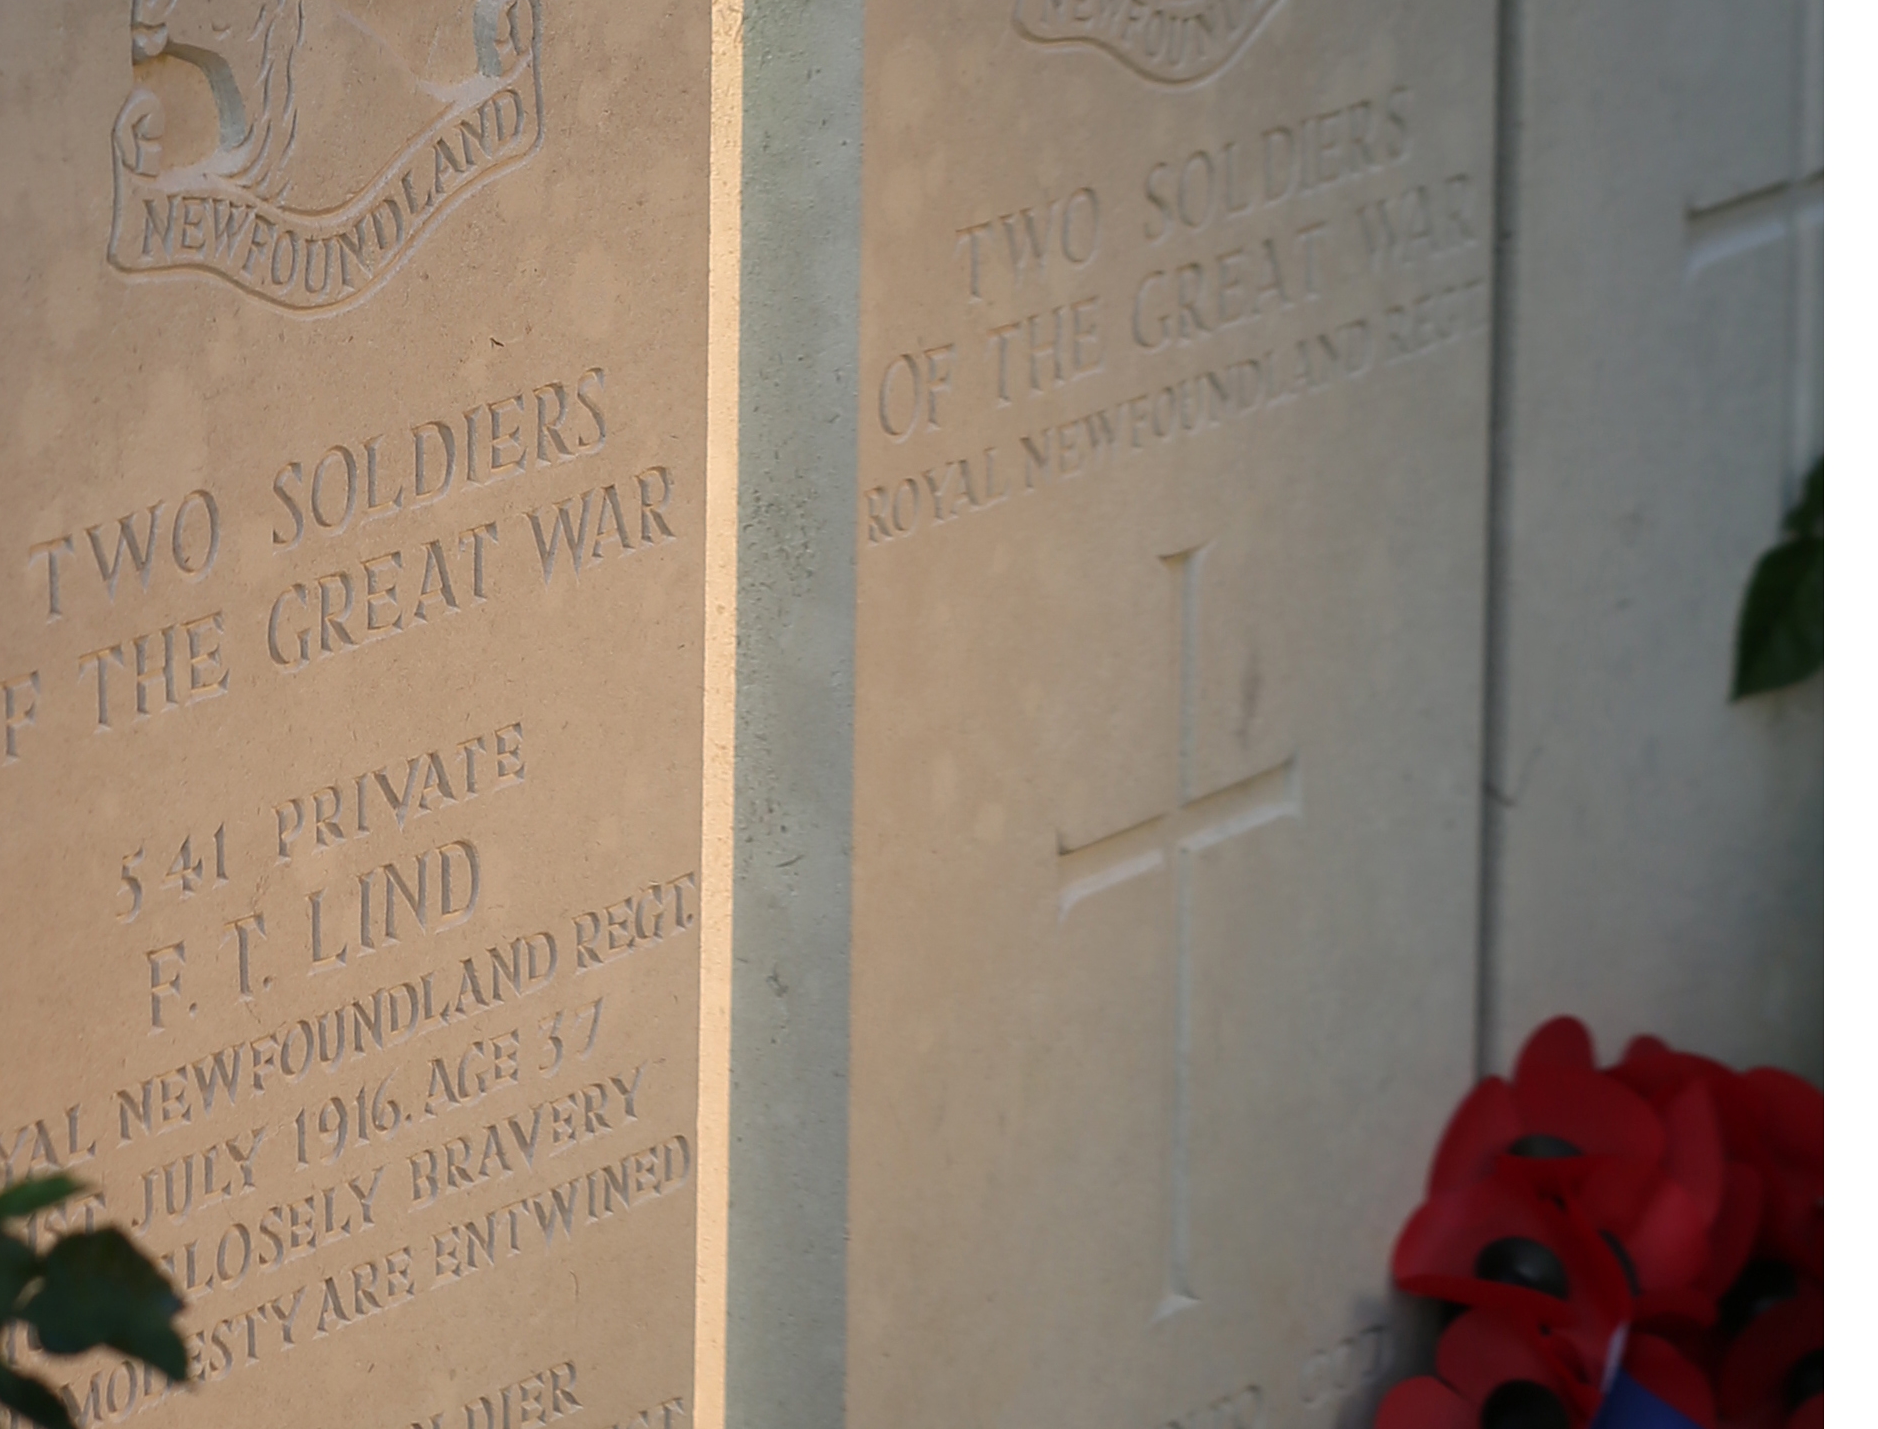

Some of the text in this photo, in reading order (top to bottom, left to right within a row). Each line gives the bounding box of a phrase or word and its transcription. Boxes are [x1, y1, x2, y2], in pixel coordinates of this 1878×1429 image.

[141, 87, 525, 297] NEWFOUNDLAND
[955, 86, 1414, 304] TWO SOLDIERS
[877, 173, 1479, 444] OF THE GREAT WAR
[28, 366, 610, 623] TWO SOLDIERS
[864, 447, 1012, 546] ROYAL
[1019, 318, 1376, 495] NEWFOUNDLAND
[77, 610, 230, 734] THE
[267, 521, 499, 673] GREAT
[522, 465, 678, 585] WAR
[115, 721, 526, 925] 541 PRIVATE
[115, 930, 559, 1147] NEWFOUNDLAND
[144, 838, 482, 1036] F. T. LIND
[130, 1125, 268, 1239] JULY
[421, 1029, 522, 1122] AGE
[537, 995, 606, 1078] 37
[405, 1058, 651, 1212] BRAVERY
[316, 1245, 417, 1339] ARE
[428, 1132, 692, 1291] ENTWINED
